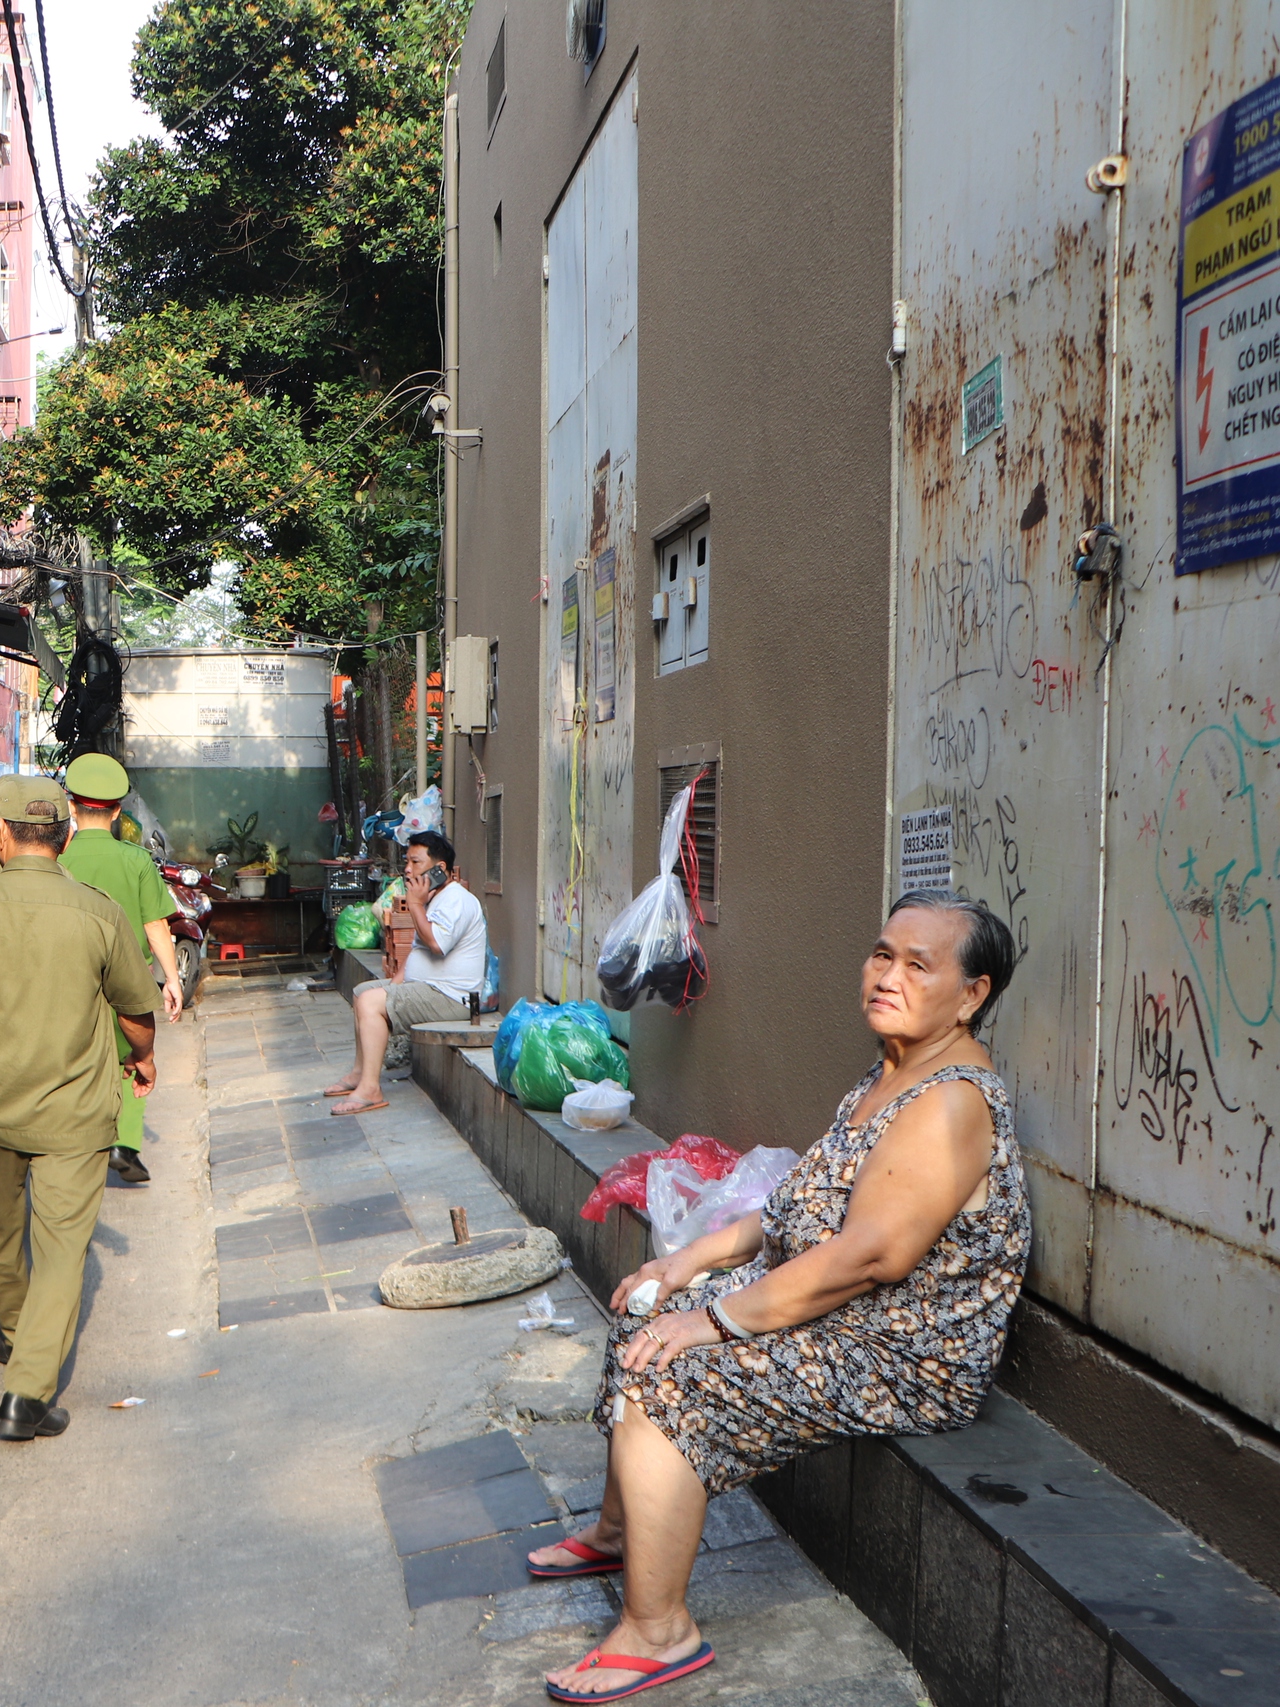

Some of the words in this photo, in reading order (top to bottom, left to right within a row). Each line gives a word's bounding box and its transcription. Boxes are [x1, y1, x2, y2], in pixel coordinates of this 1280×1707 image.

[1234, 119, 1270, 157] 1900
[1227, 185, 1271, 227] TRẠM
[1195, 242, 1234, 284] PHẠM
[1238, 218, 1272, 260] NGŨ
[1218, 307, 1248, 341] CẤM
[1250, 297, 1272, 329] LẠI
[1238, 343, 1256, 372] CÓ
[1228, 375, 1264, 409] NGUY
[1225, 408, 1258, 442] CHẾT
